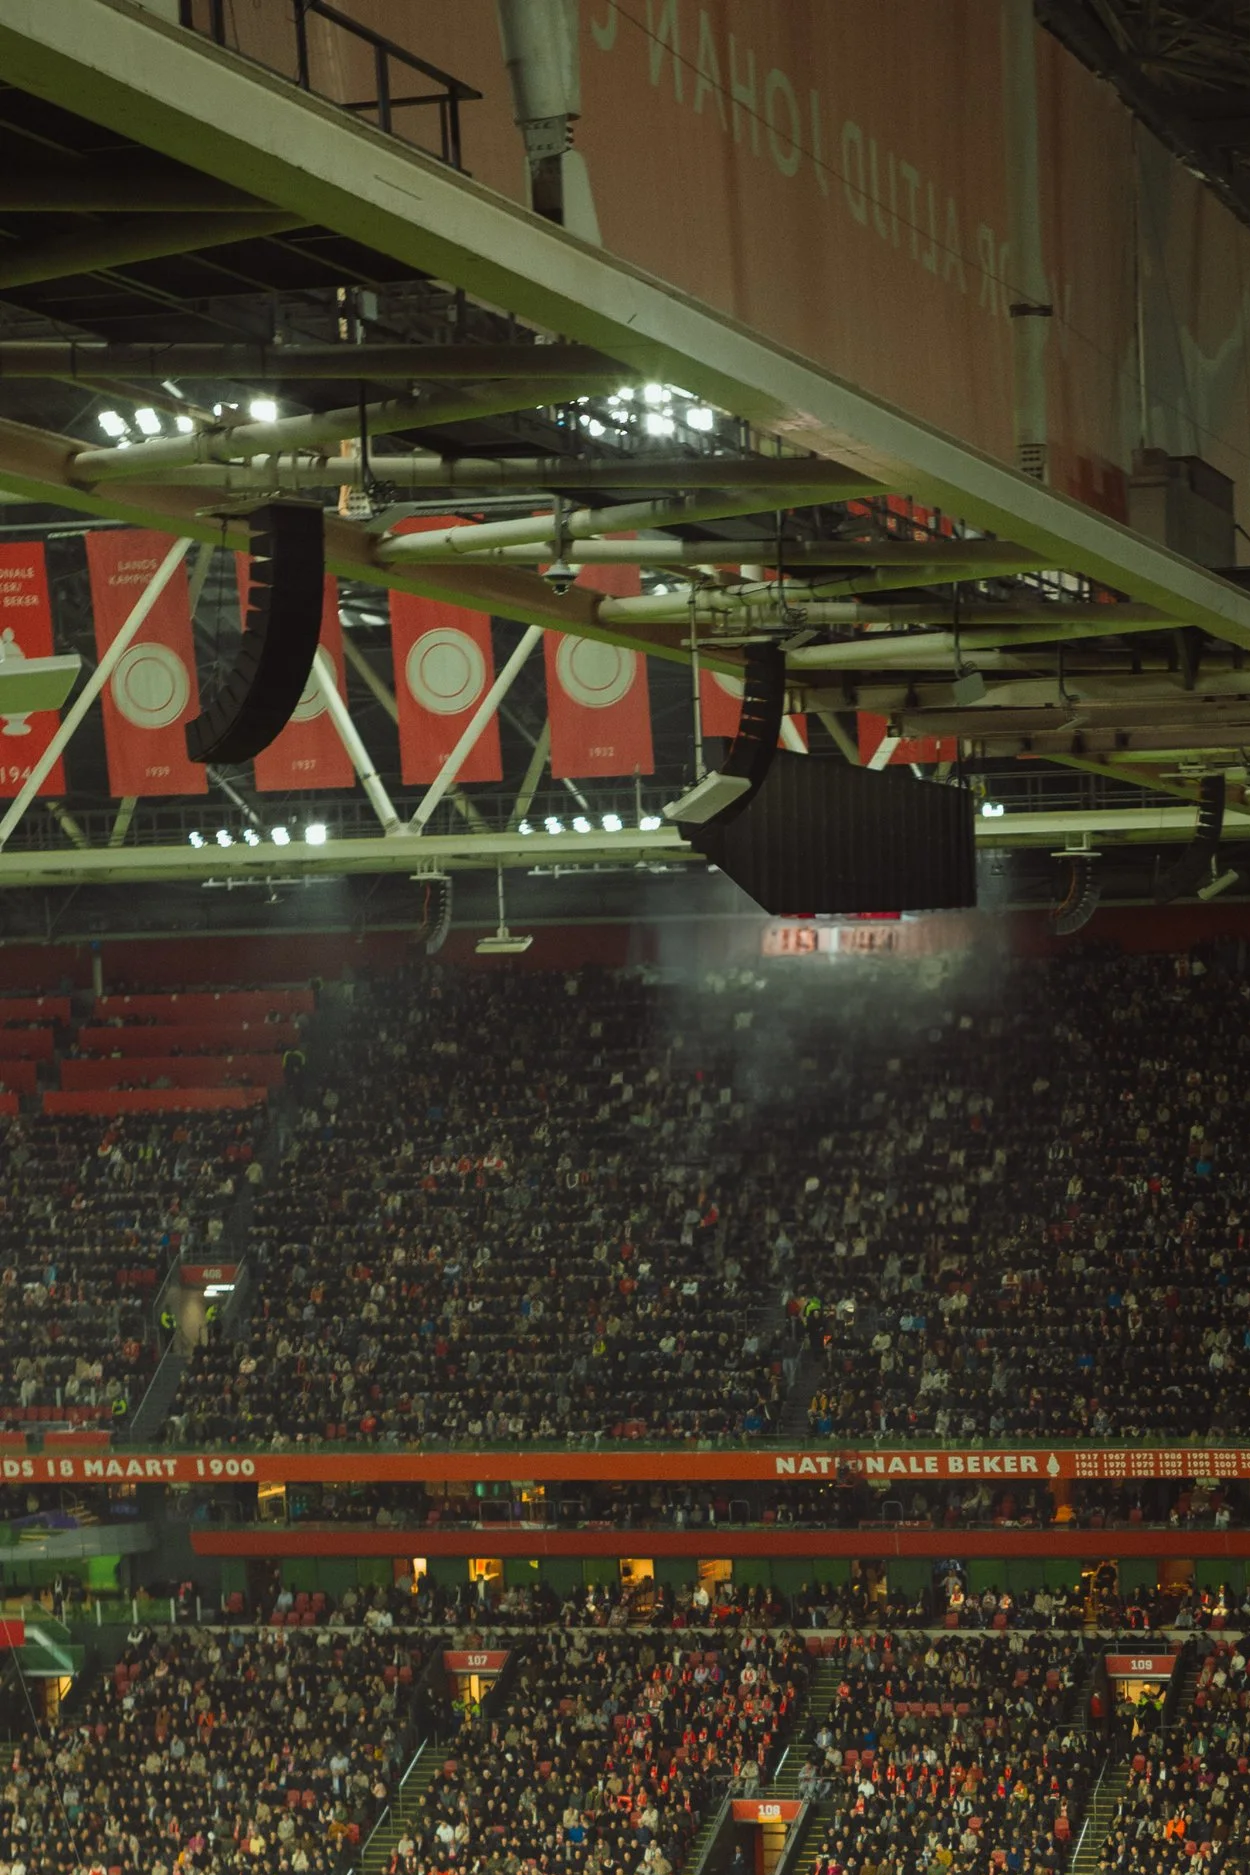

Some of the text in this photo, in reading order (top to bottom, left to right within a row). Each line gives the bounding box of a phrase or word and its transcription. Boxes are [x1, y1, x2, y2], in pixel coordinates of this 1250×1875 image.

[0, 766, 32, 784] 194
[1075, 1452, 1099, 1460] 1917
[0, 1458, 255, 1477] DS 18 MAART 1900
[948, 1455, 1039, 1474] BEKER
[467, 1655, 488, 1667] 107
[1130, 1659, 1153, 1671] 109
[757, 1804, 781, 1817] 108
